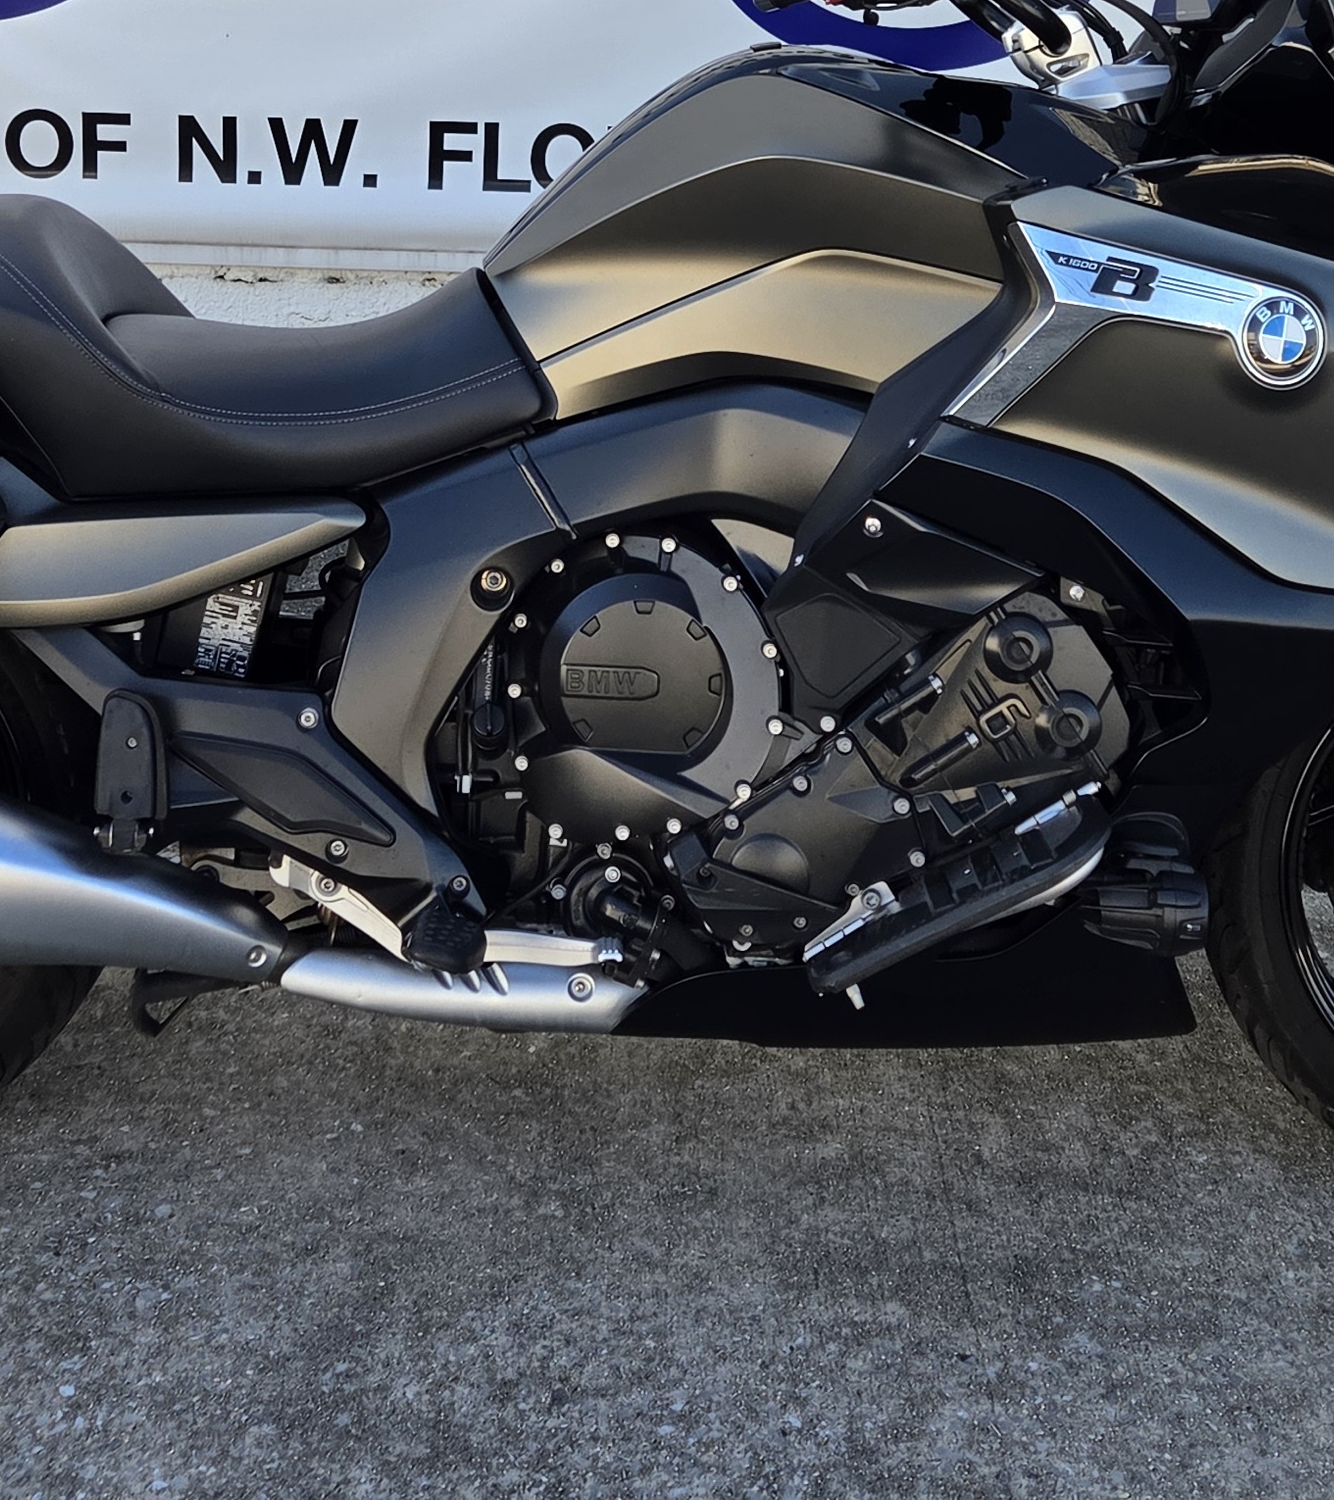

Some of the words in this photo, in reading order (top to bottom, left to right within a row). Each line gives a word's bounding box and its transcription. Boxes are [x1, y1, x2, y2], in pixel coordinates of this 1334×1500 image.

[5, 109, 131, 179] OF
[178, 115, 378, 188] N.W.
[428, 121, 612, 193] FLO
[1058, 256, 1068, 265] K
[1069, 258, 1098, 270] 1600
[1090, 256, 1159, 302] B
[1256, 301, 1315, 331] BMW
[566, 668, 641, 695] BMW
